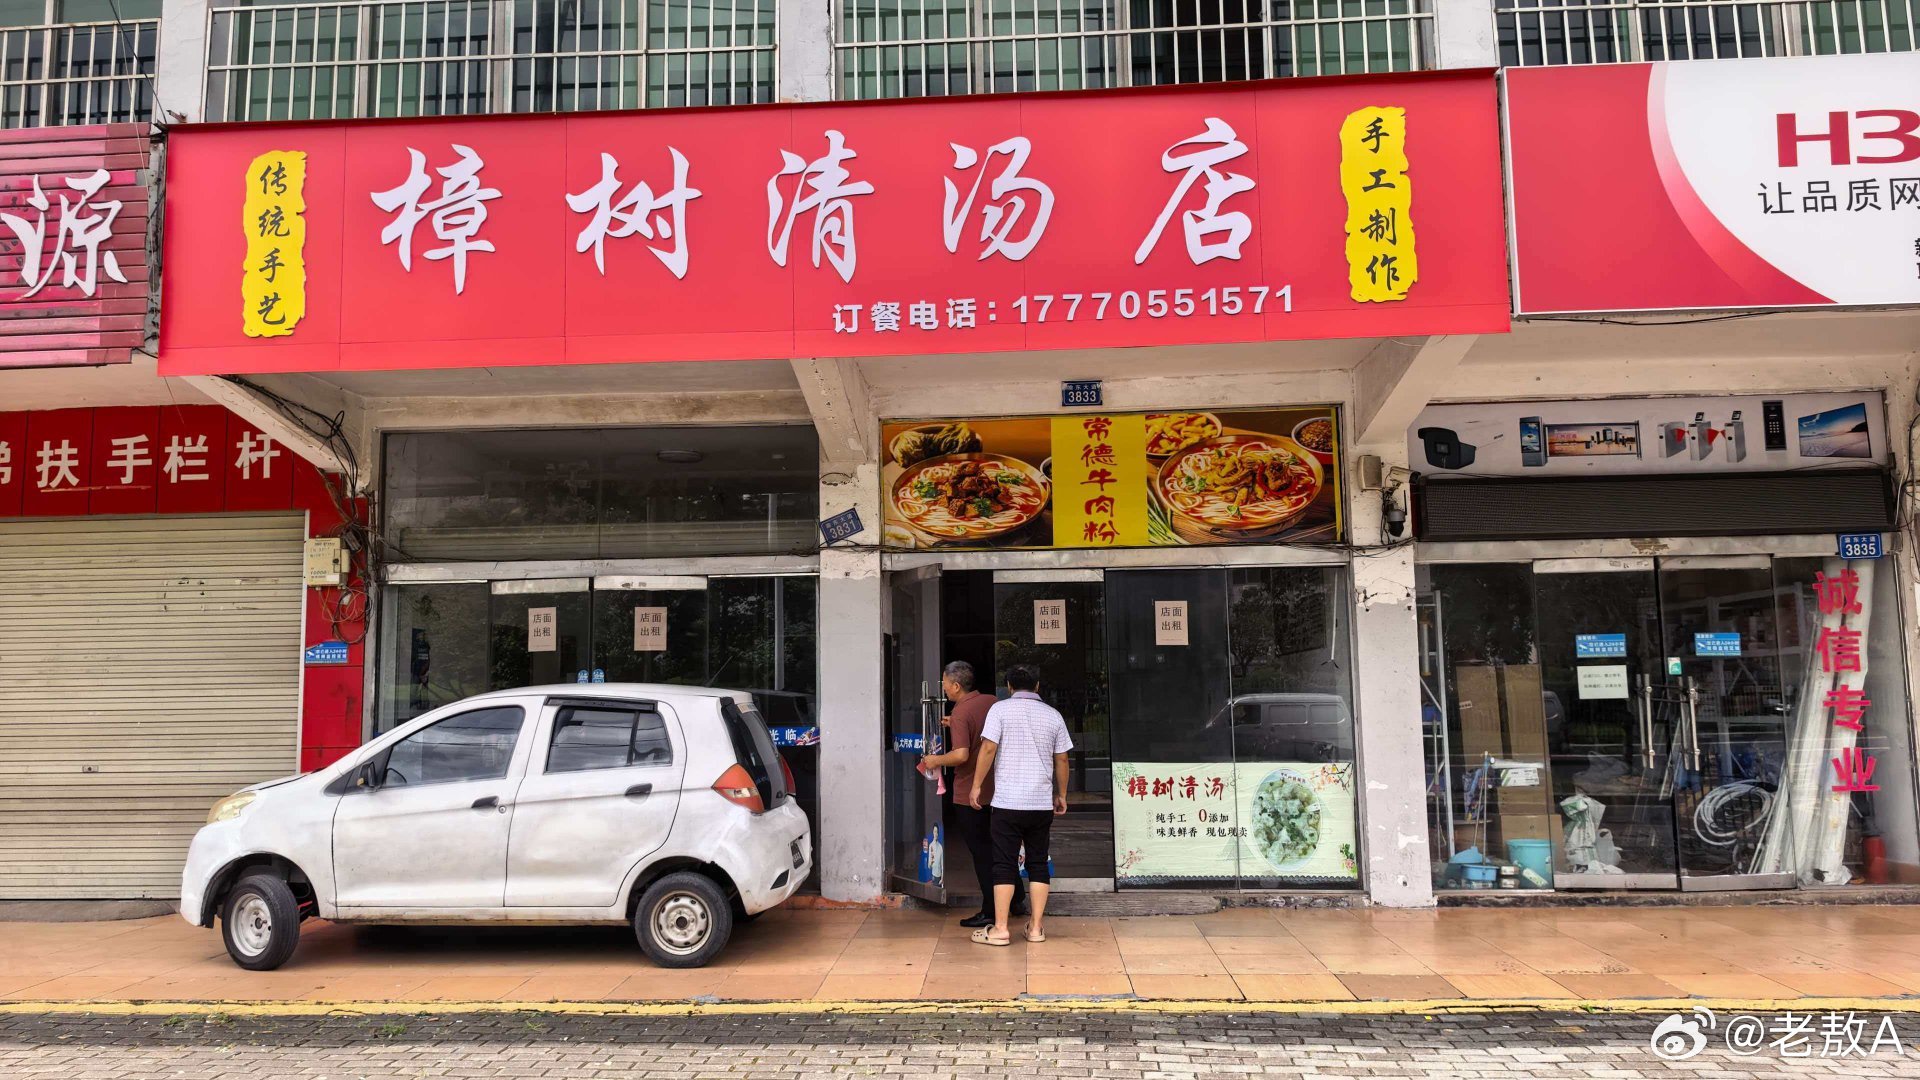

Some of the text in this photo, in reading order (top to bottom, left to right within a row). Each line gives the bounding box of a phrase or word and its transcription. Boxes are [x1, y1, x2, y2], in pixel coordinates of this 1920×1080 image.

[1360, 116, 1401, 290] 手工制作
[1757, 177, 1920, 215] 让品质网
[371, 116, 1257, 295] 樟树清汤店
[0, 168, 128, 298] 源
[257, 161, 290, 326] 传统手艺
[1068, 391, 1097, 403] 3833
[1080, 416, 1120, 544] 常德牛肉粉
[830, 518, 857, 539] 3831
[1845, 543, 1877, 557] 3835
[639, 612, 663, 623] 店面
[1039, 605, 1061, 616] 店面
[1160, 606, 1182, 617] 店面
[532, 613, 552, 624] 店面
[1040, 619, 1060, 630] 出租
[1161, 620, 1182, 631] 出租
[533, 626, 552, 638] 出租
[639, 625, 661, 637] 出租
[1812, 568, 1881, 793] 诚信专业
[1127, 774, 1224, 801] 樟树清汤
[1155, 808, 1229, 824] 纯手工 0添加
[1156, 826, 1248, 838] 味美鲜香 现包现卖
